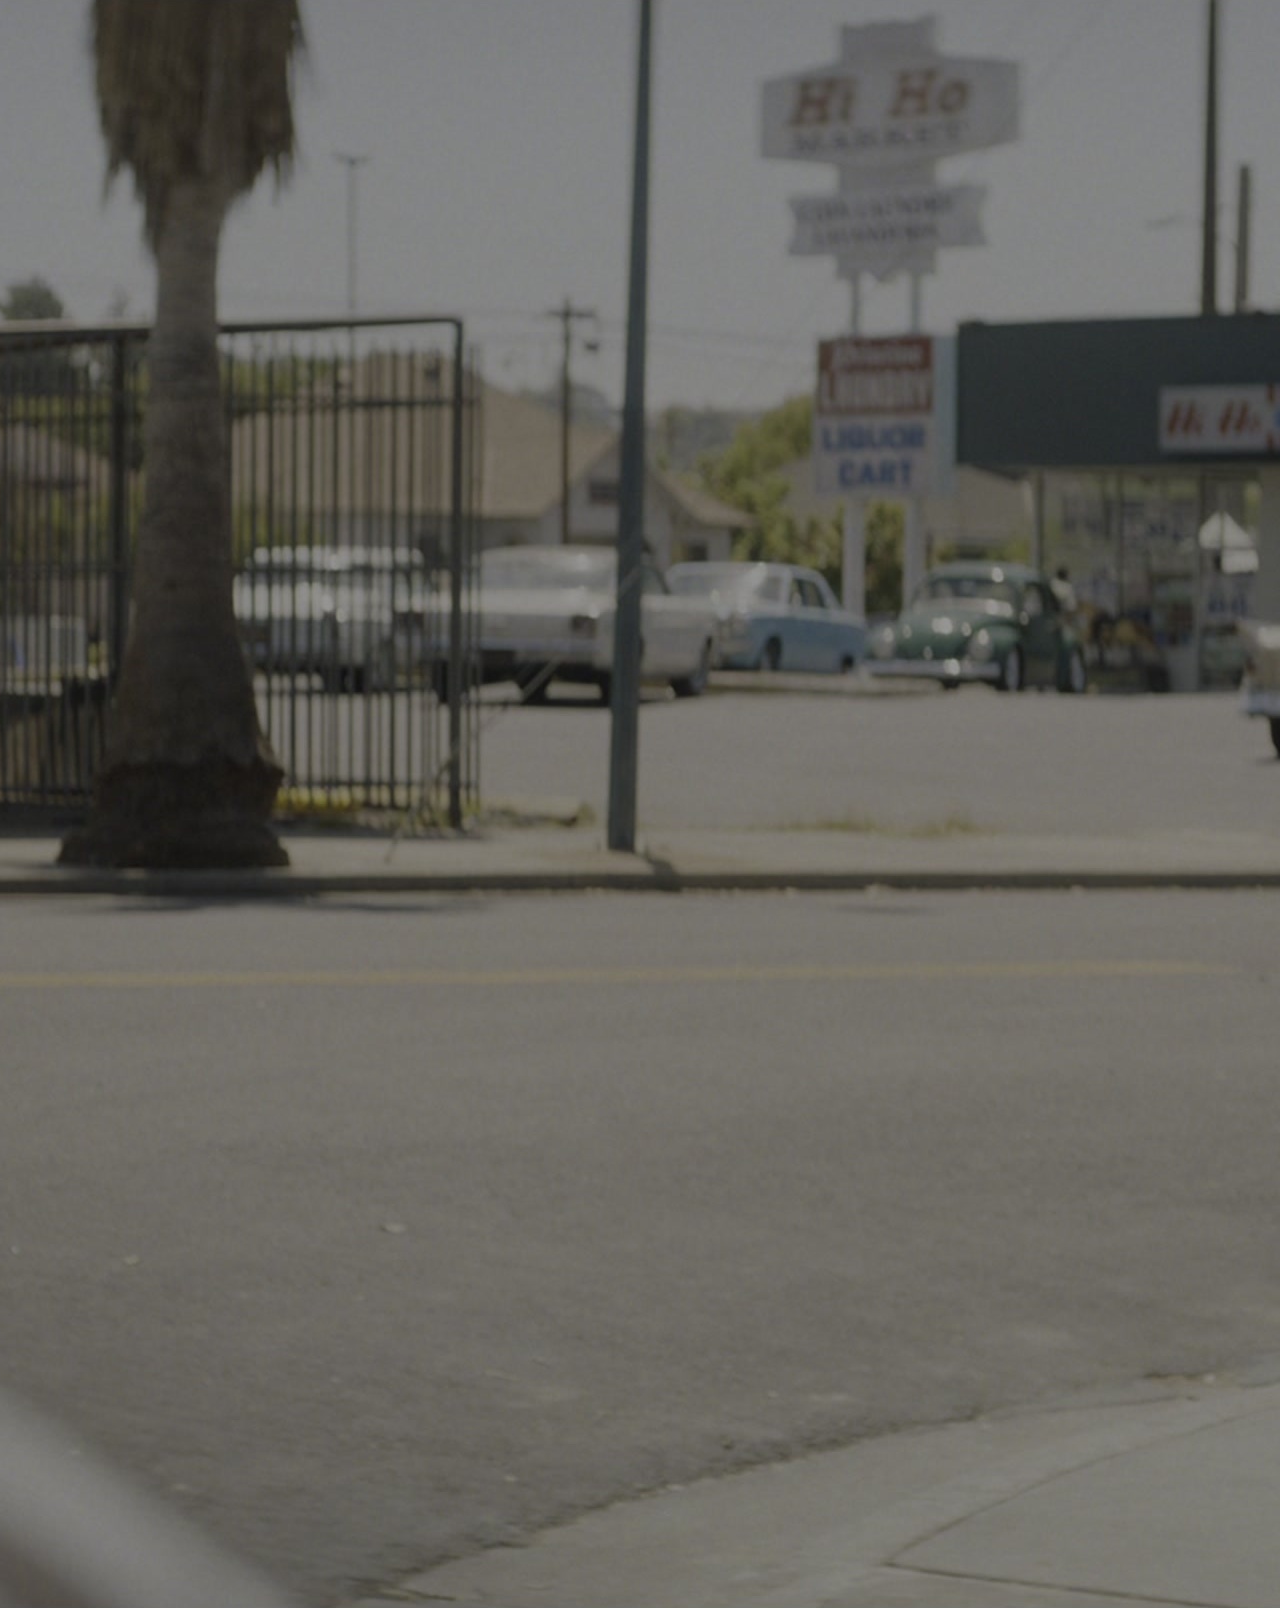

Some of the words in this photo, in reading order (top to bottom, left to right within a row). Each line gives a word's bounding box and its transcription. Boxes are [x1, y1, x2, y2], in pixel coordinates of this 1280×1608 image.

[788, 79, 856, 125] Hi
[888, 69, 970, 117] Ho
[795, 122, 966, 151] MARKET
[822, 424, 926, 451] LIQUOR
[838, 458, 912, 487] CART
